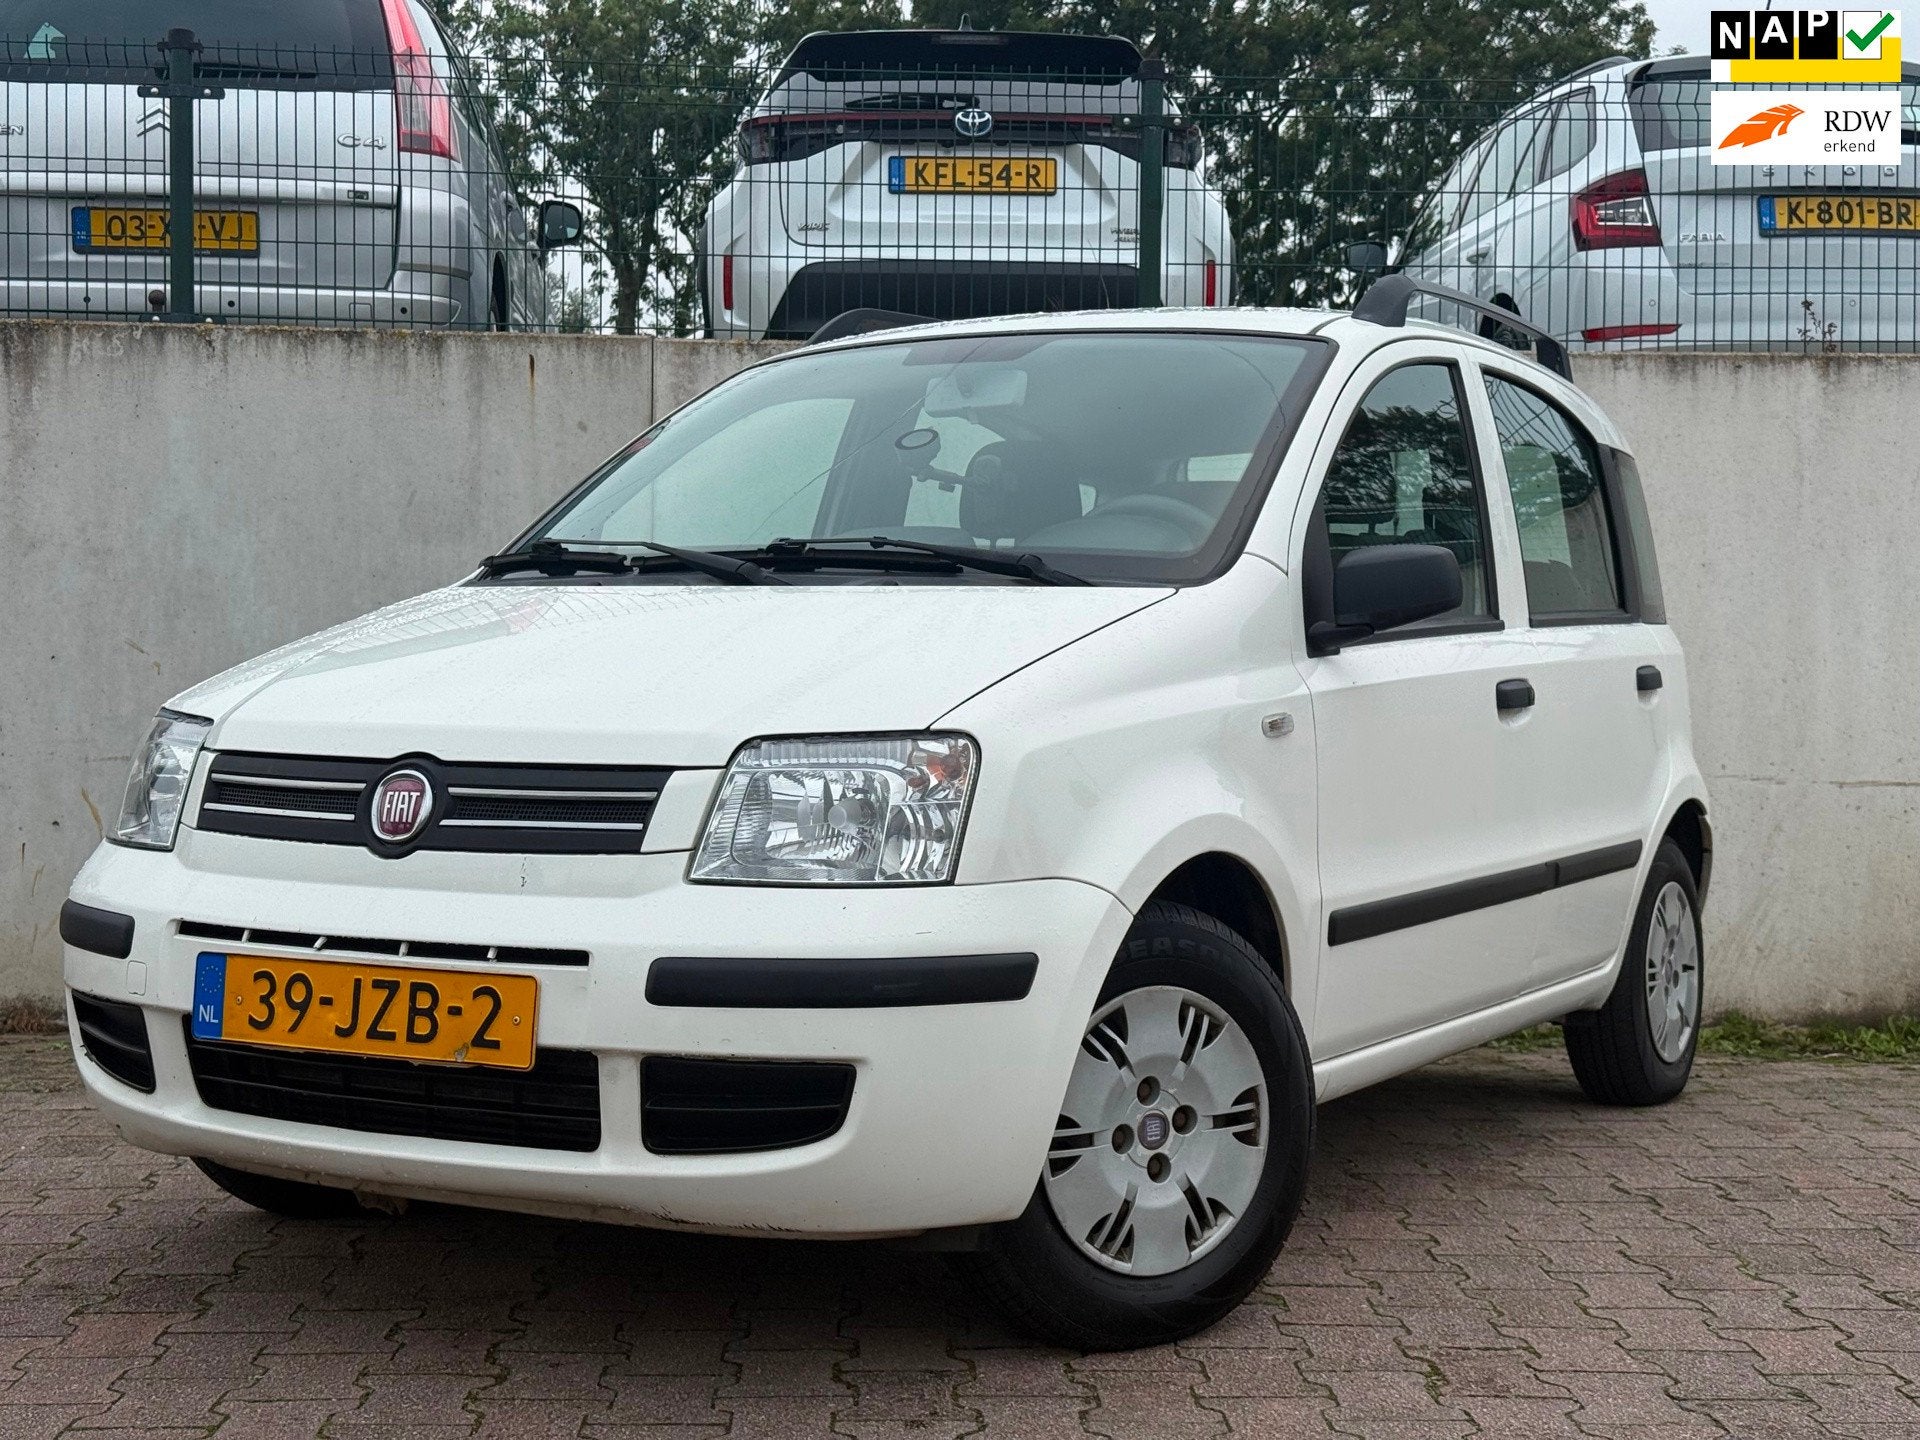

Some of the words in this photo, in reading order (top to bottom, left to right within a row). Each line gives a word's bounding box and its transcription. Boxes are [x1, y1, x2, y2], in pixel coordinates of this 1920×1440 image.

[337, 133, 386, 150] C4
[914, 162, 1041, 188] KFL-54-R
[1788, 200, 1913, 225] K-801-BR
[107, 214, 243, 241] 03-X-VJ
[383, 791, 421, 823] FIAT
[198, 1003, 219, 1024] NL
[248, 969, 503, 1050] 39-JZB-2
